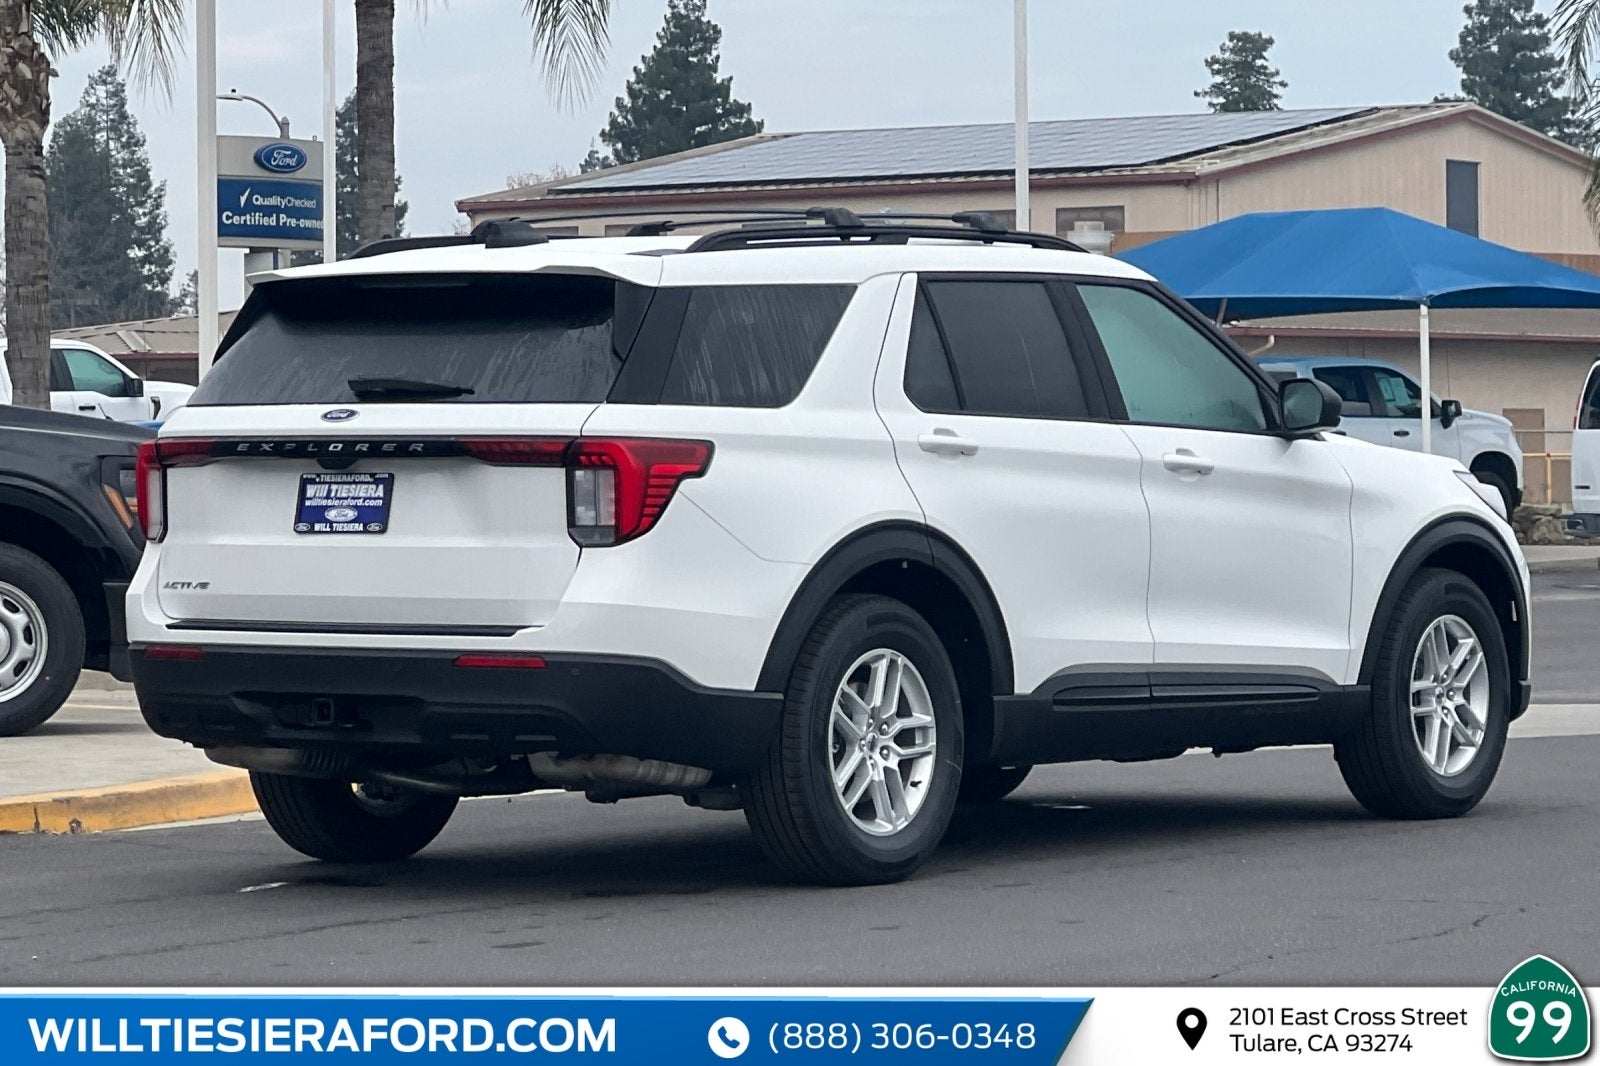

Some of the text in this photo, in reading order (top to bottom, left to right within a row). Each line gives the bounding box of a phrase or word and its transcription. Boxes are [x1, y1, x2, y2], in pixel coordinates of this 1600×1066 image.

[270, 149, 298, 166] Ford
[222, 211, 277, 226] Certified
[236, 443, 424, 452] EXPLORER
[330, 484, 384, 498] TIESIERA
[304, 498, 383, 507] willtiesieraford.com
[314, 523, 331, 532] WILL
[332, 523, 364, 532] TIESIERA
[163, 581, 211, 590] ACTIVE
